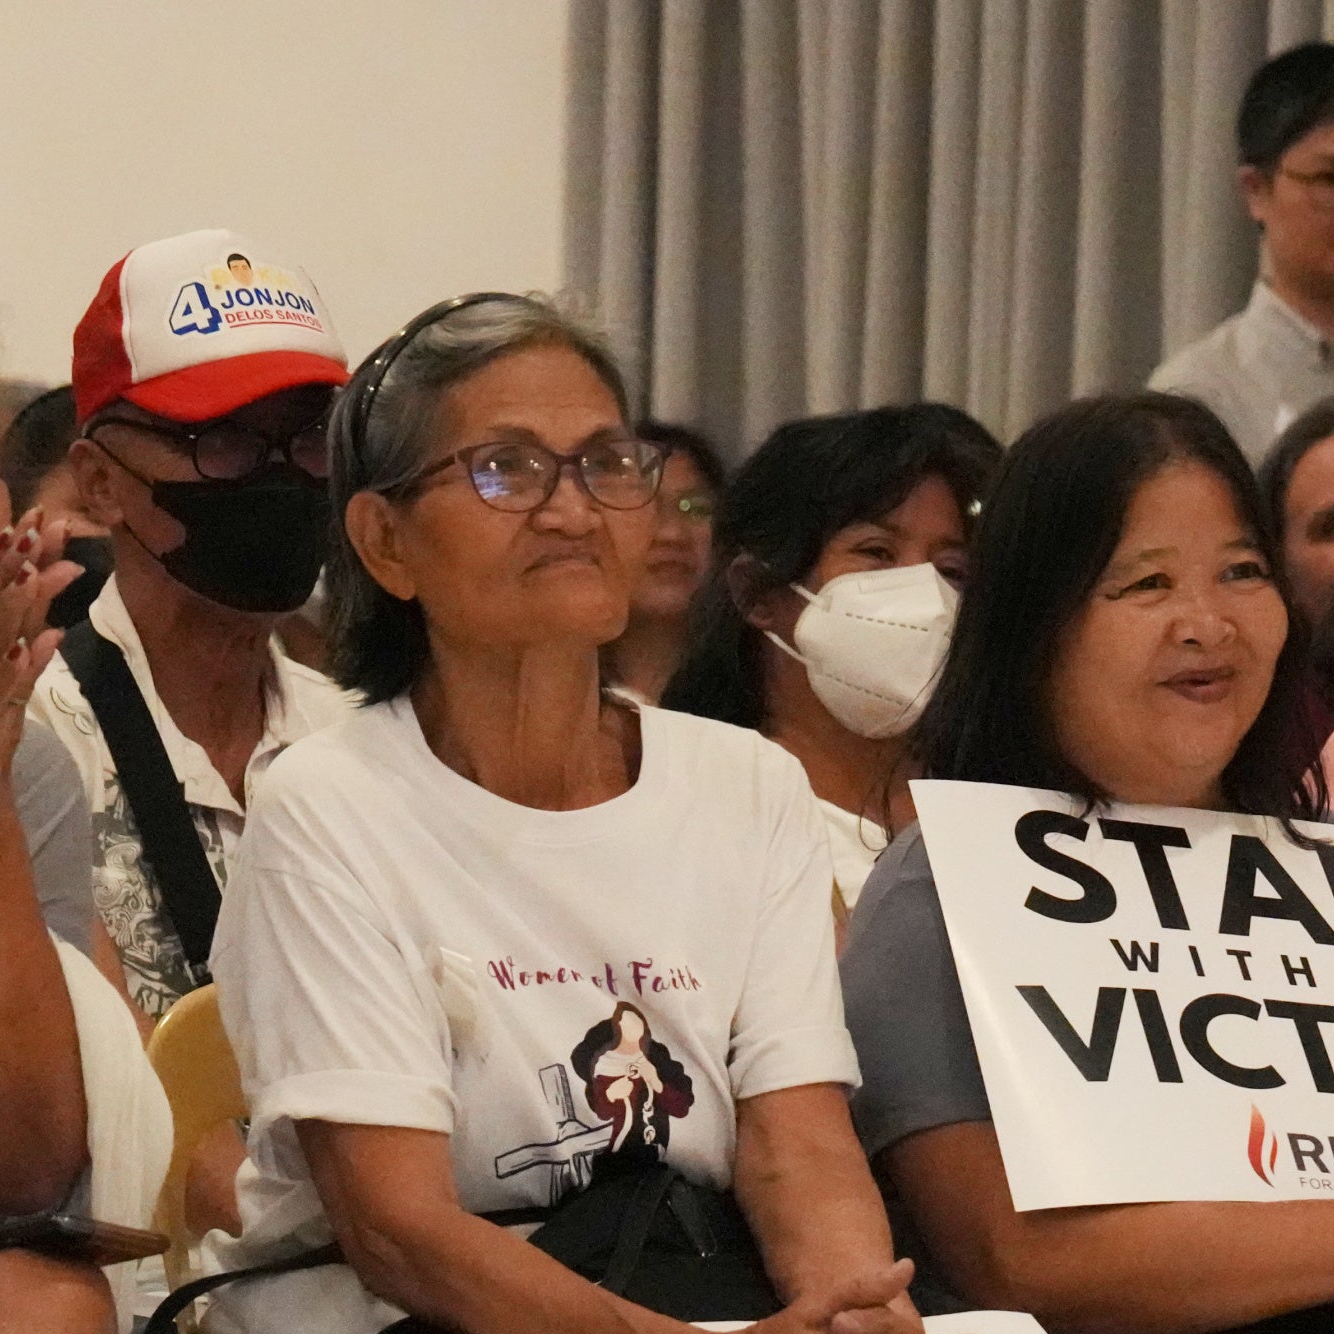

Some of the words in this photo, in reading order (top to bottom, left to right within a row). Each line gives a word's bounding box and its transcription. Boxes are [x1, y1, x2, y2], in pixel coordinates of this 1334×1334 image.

[169, 281, 222, 336] 4
[220, 287, 316, 316] JONJON
[224, 309, 274, 324] DELOS
[486, 955, 583, 992] Women
[591, 961, 619, 997] of
[626, 957, 703, 998] Faith
[1109, 937, 1318, 988] WITH
[1299, 1176, 1334, 1192] FOR
